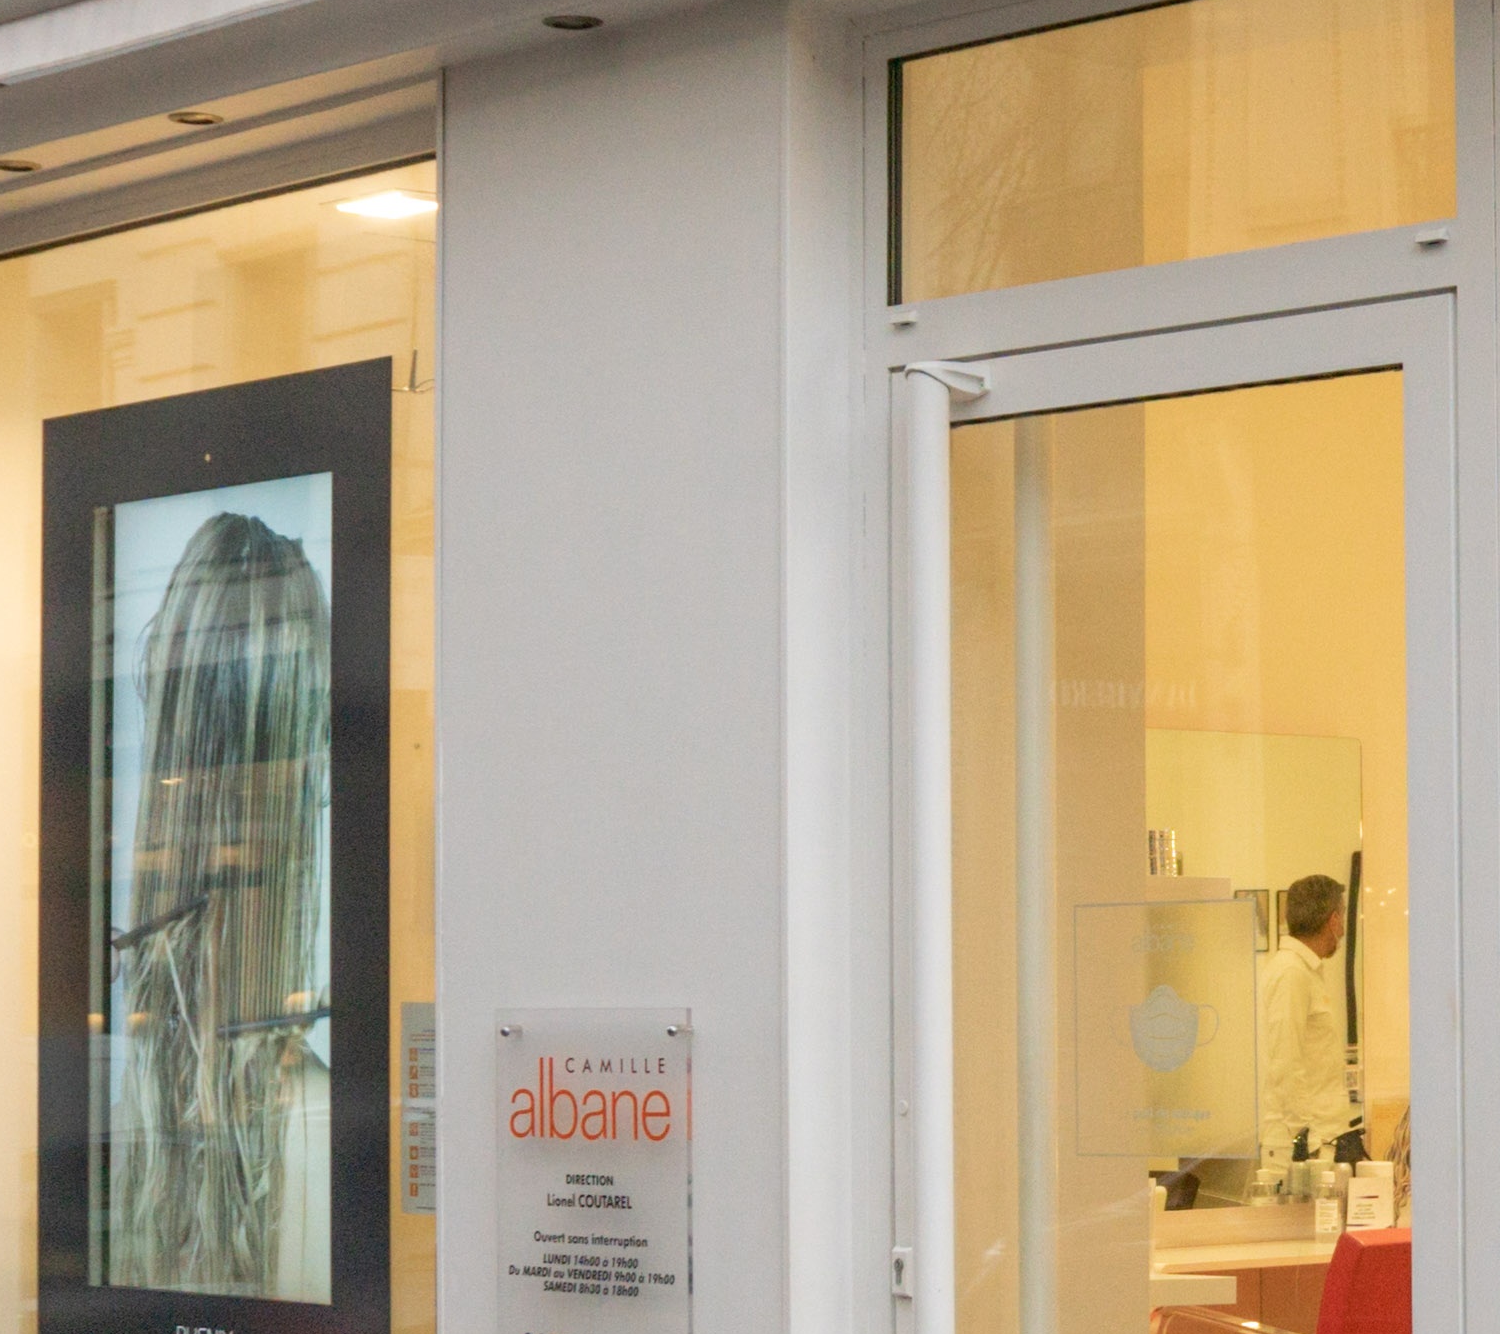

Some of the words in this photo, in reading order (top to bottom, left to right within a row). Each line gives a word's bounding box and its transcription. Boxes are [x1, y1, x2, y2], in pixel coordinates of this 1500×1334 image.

[565, 1057, 668, 1074] CAMILLE
[509, 1056, 672, 1142] albane
[565, 1174, 614, 1186] DIRECTION
[546, 1193, 576, 1208] Lionel
[578, 1194, 633, 1210] COUTAREL
[533, 1230, 566, 1244] Ouvert
[567, 1236, 589, 1245] sans
[591, 1233, 649, 1249] interruption
[542, 1253, 571, 1266] LUNDI
[573, 1254, 600, 1267] 14h00
[611, 1256, 639, 1269] 19h00
[508, 1264, 521, 1276] Du
[522, 1265, 552, 1278] MARDI
[553, 1270, 565, 1278] au
[567, 1268, 612, 1282] VENDREDI
[614, 1271, 637, 1283] 9h00
[648, 1273, 676, 1285] 19h00
[543, 1280, 577, 1293] SAMEDI
[578, 1282, 601, 1295] 8h30
[611, 1285, 640, 1297] 18h00
